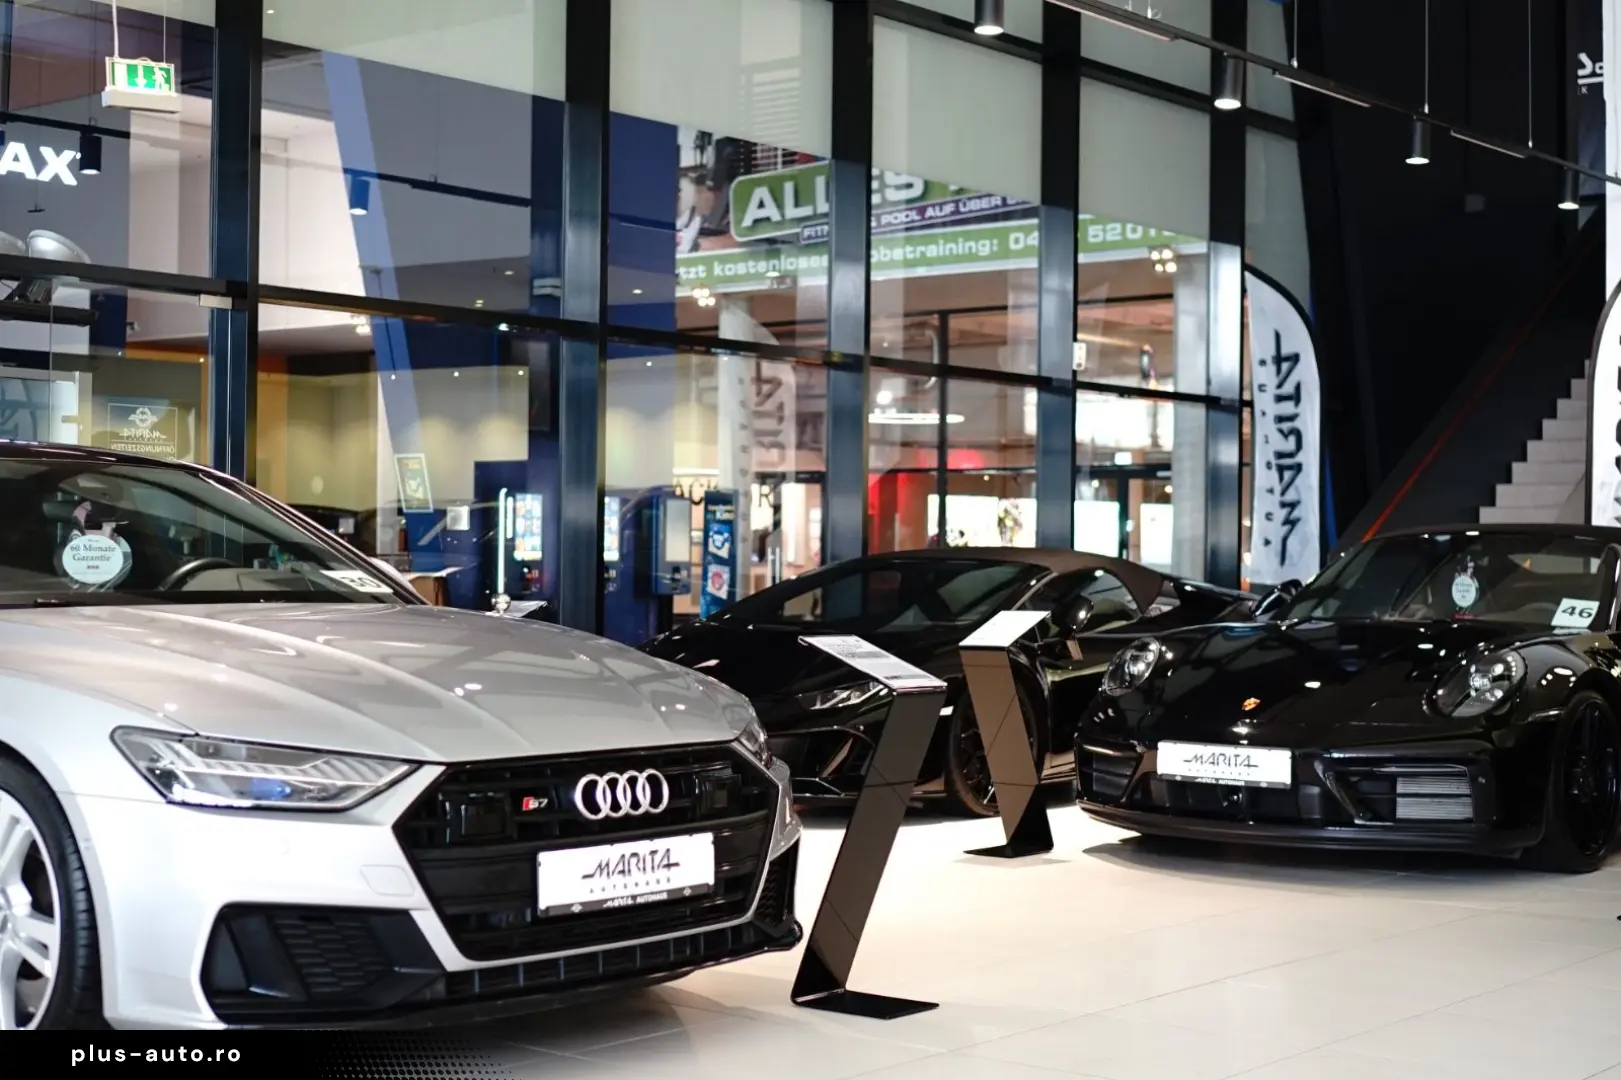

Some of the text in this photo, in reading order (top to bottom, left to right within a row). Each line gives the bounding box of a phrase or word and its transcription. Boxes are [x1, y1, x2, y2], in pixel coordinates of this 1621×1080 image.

[880, 209, 922, 226] POOL
[924, 202, 955, 219] AUF
[958, 195, 1003, 213] ÜBER
[677, 264, 707, 280] tzt
[82, 543, 117, 553] Monate
[72, 552, 112, 562] Garantie
[1561, 605, 1594, 619] 46
[1183, 752, 1260, 769] MARITA
[528, 797, 549, 811] S7
[581, 848, 681, 881] MARITA
